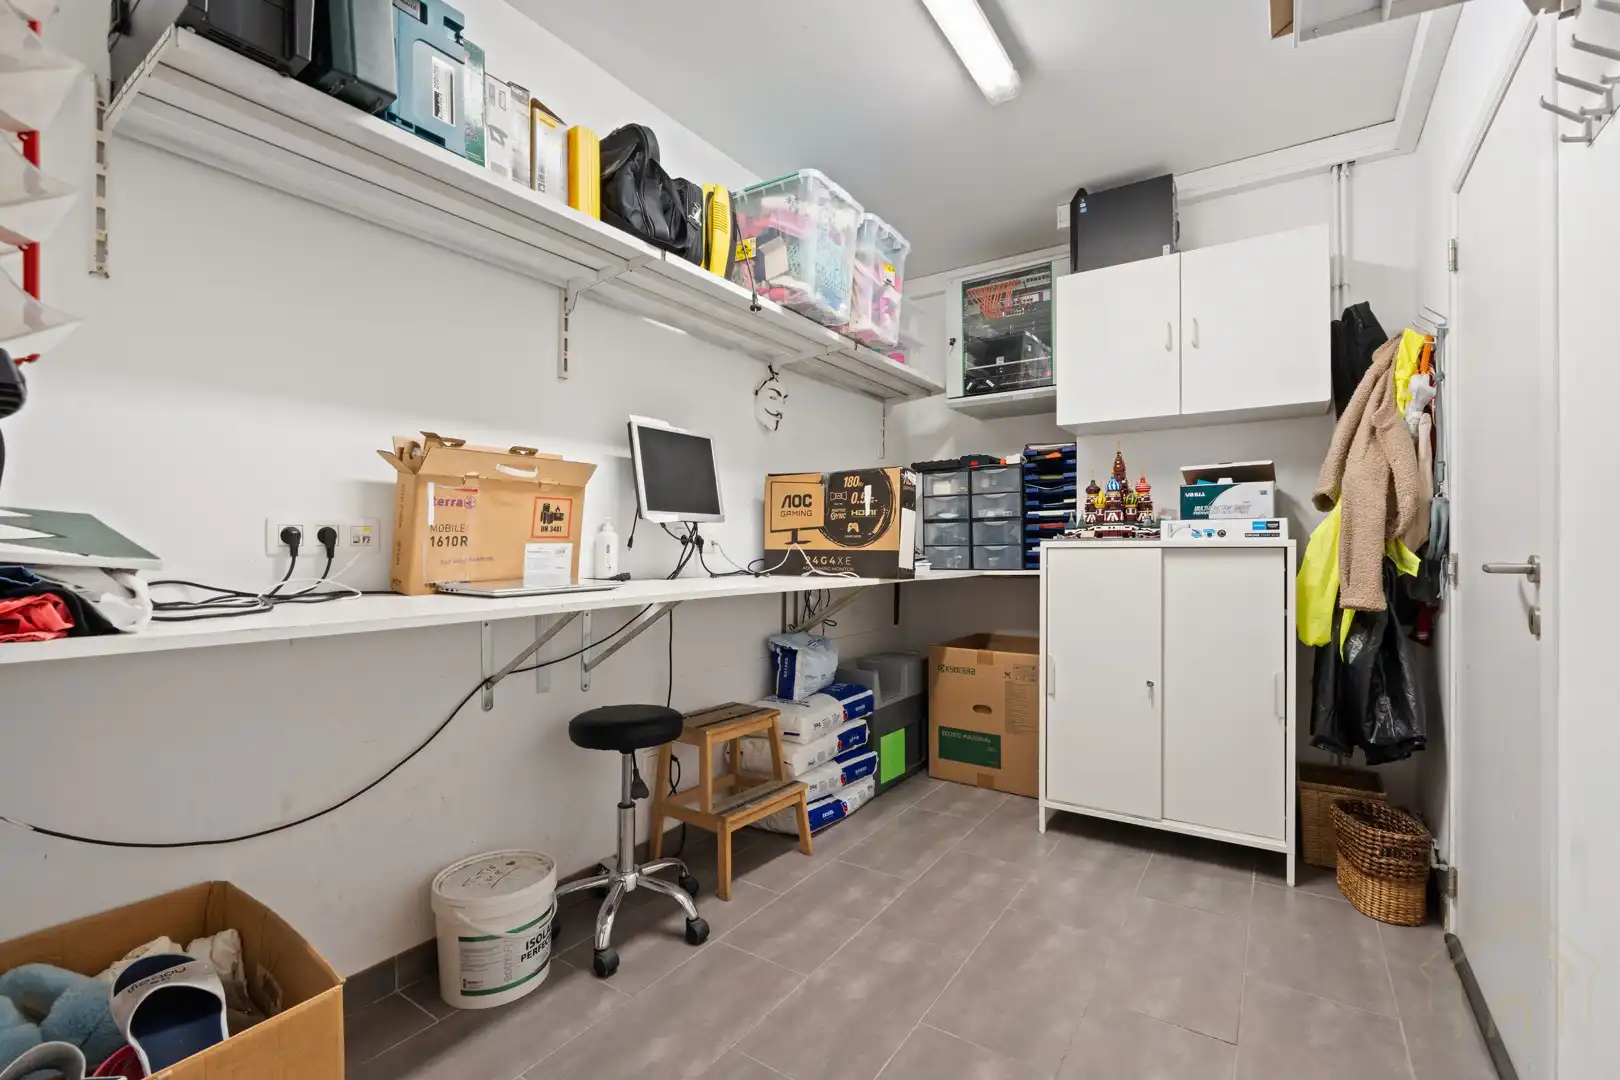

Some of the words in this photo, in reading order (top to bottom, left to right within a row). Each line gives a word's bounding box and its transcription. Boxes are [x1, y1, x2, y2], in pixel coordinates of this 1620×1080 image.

[433, 496, 463, 507] terra
[781, 493, 813, 509] AOC
[780, 509, 813, 518] GAMING
[429, 523, 466, 533] MOBILE
[540, 525, 549, 533] UN
[550, 525, 562, 533] 3481
[429, 535, 469, 548] 1610R
